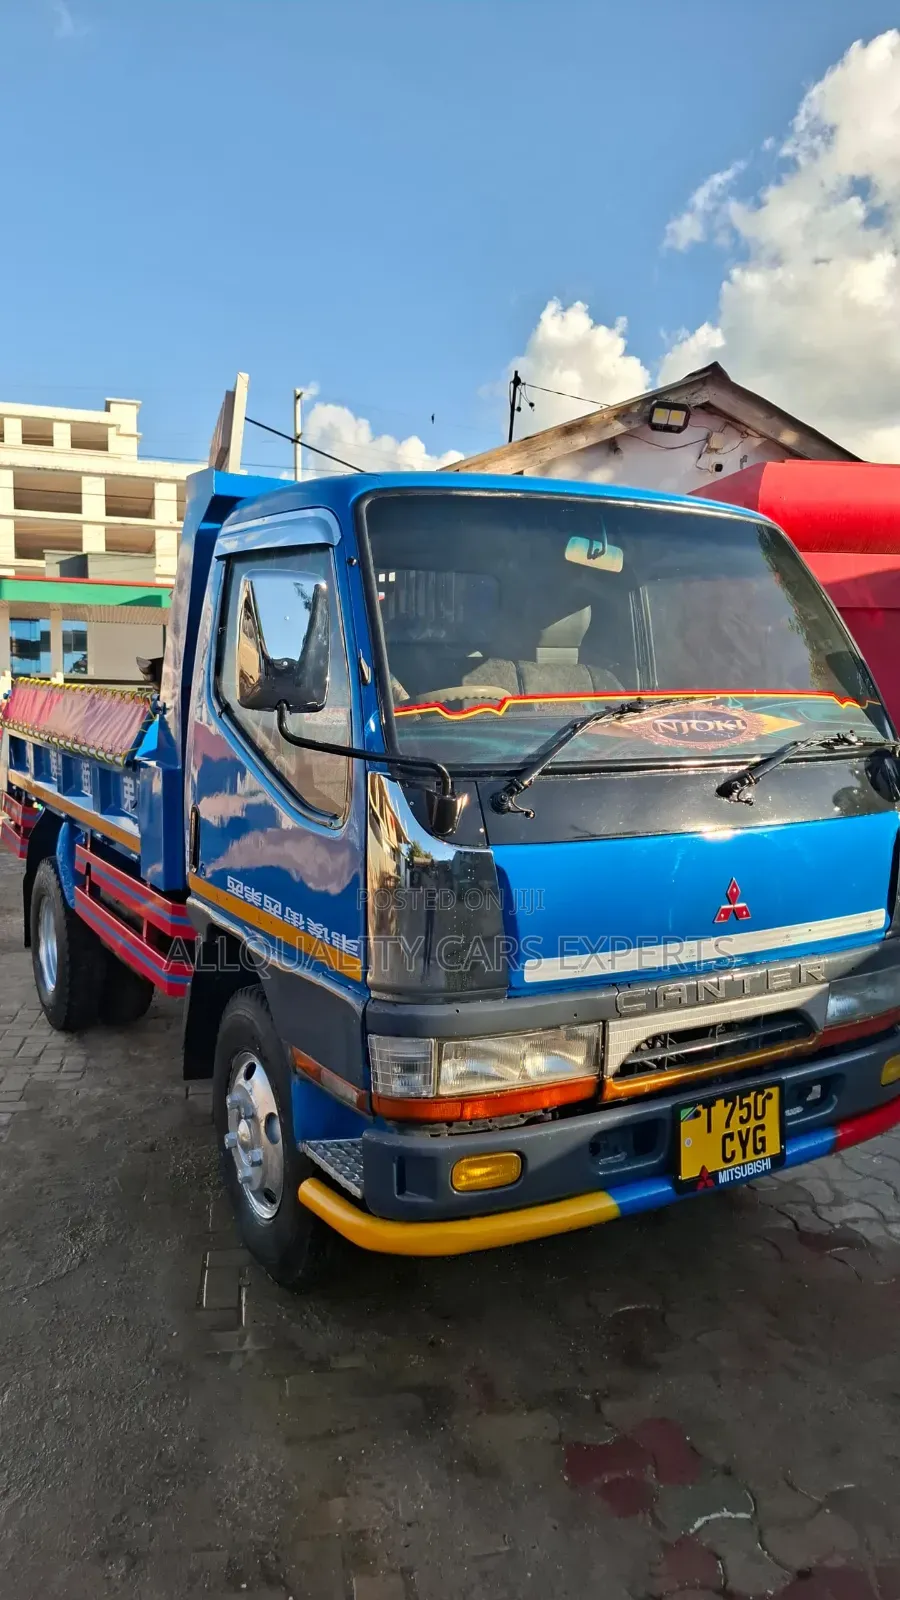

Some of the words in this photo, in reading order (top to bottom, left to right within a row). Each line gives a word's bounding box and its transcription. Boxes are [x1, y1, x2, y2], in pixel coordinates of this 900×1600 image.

[656, 718, 747, 735] NJOKI
[615, 959, 827, 1014] CANTER
[700, 1104, 717, 1134] T
[723, 1089, 768, 1129] 750
[721, 1123, 767, 1164] CYG
[718, 1158, 771, 1184] MITSUBISHI
